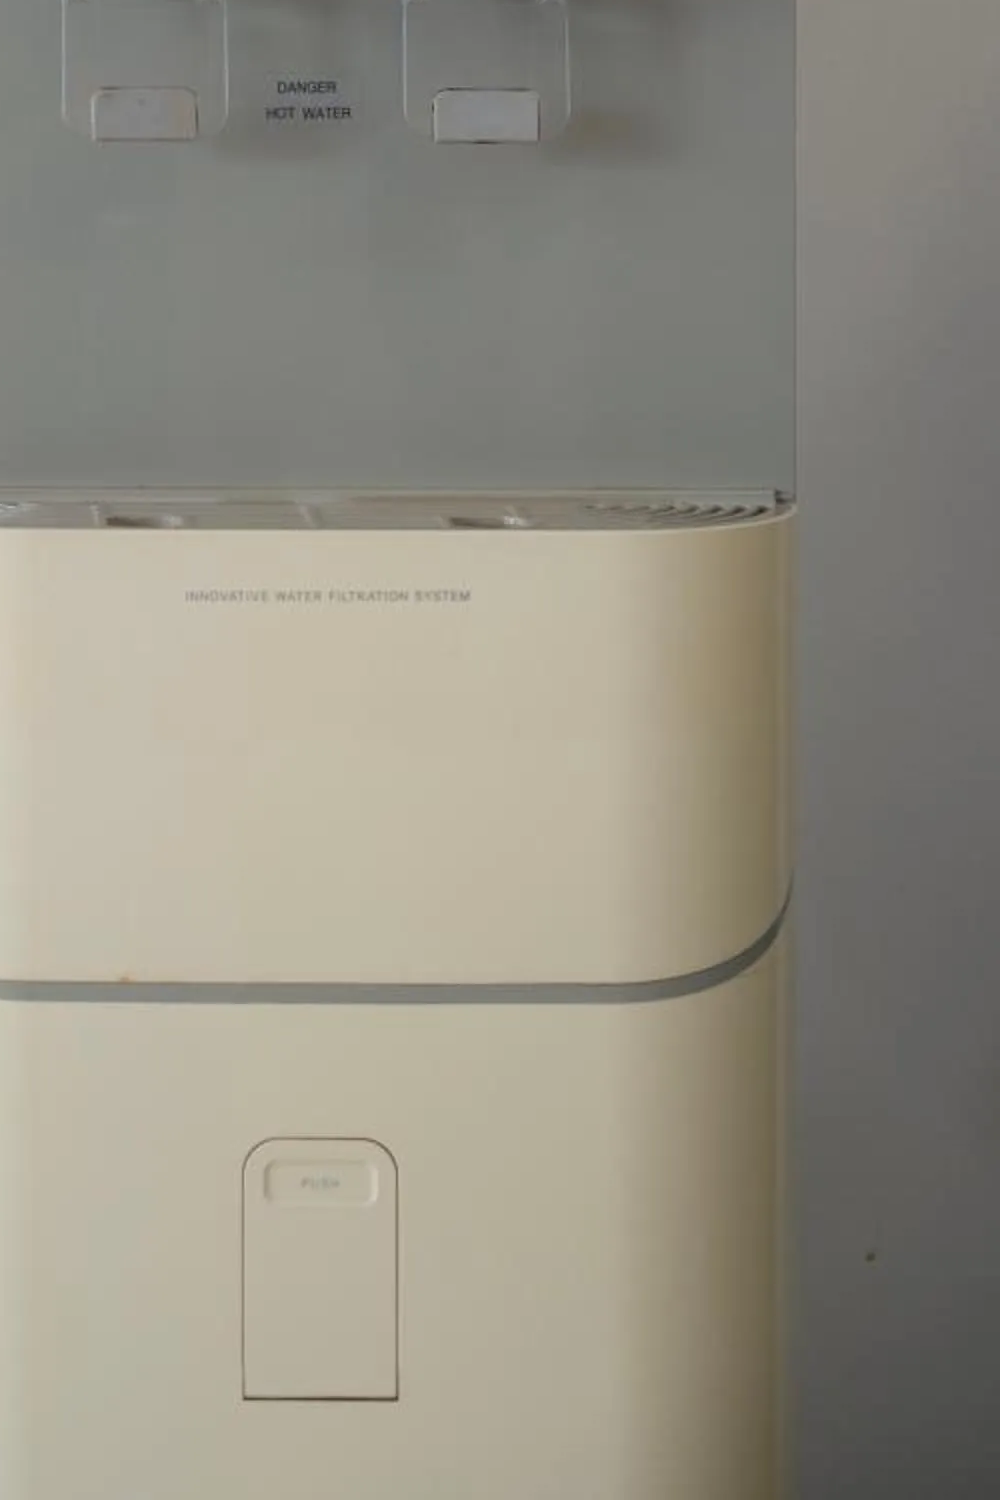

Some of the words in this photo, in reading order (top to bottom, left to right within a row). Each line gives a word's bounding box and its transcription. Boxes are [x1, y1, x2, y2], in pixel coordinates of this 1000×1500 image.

[277, 80, 337, 95] DANGER
[265, 106, 296, 121] HOT
[302, 106, 352, 121] WATER
[184, 589, 268, 602] INNOVATIVE
[275, 589, 322, 602] WATER
[328, 589, 409, 603] FILTRATION
[414, 589, 471, 603] SYSTEM
